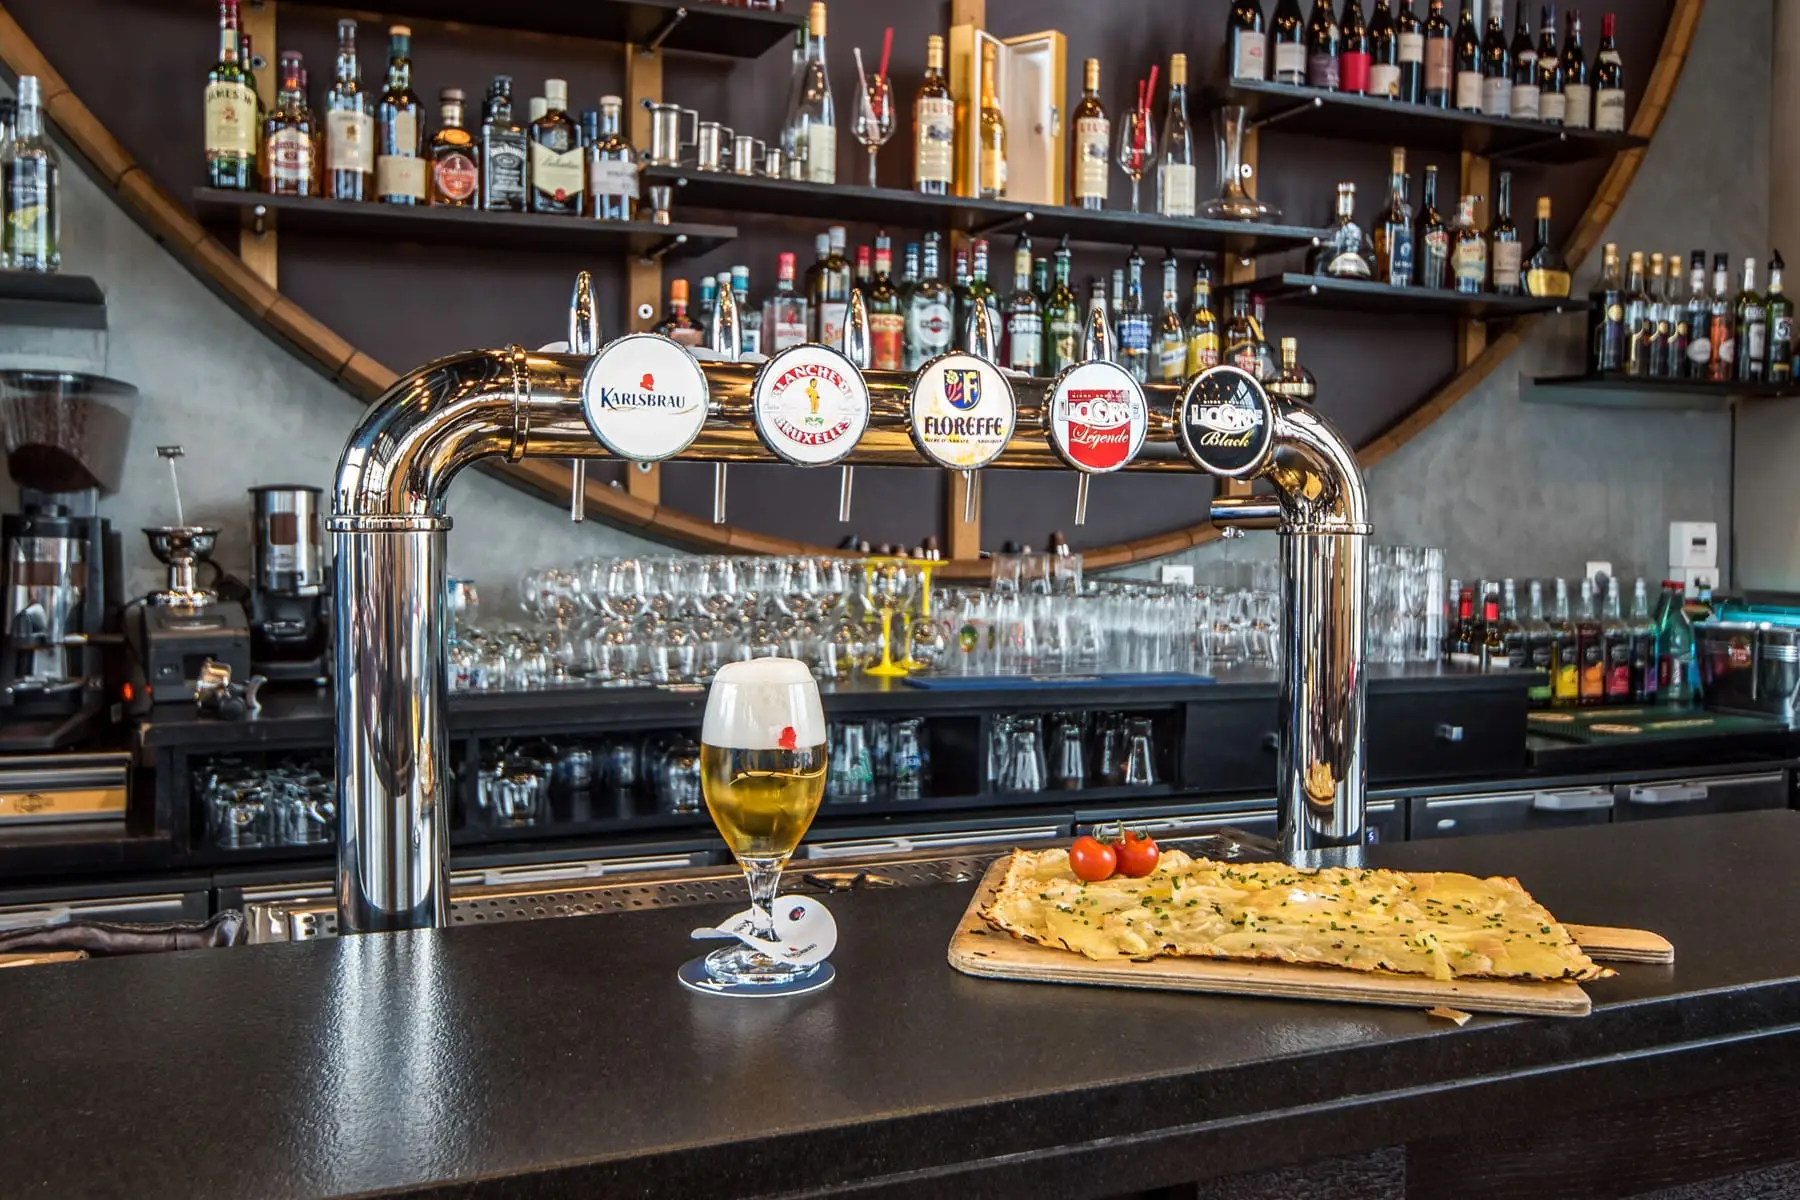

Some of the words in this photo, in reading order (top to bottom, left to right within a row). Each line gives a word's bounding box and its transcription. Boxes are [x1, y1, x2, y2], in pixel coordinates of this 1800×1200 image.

[207, 87, 252, 106] JAMESN
[925, 416, 1003, 436] FLOREFFE
[1191, 404, 1263, 428] LICORNE
[1071, 424, 1130, 450] Légende
[1200, 430, 1255, 447] Black
